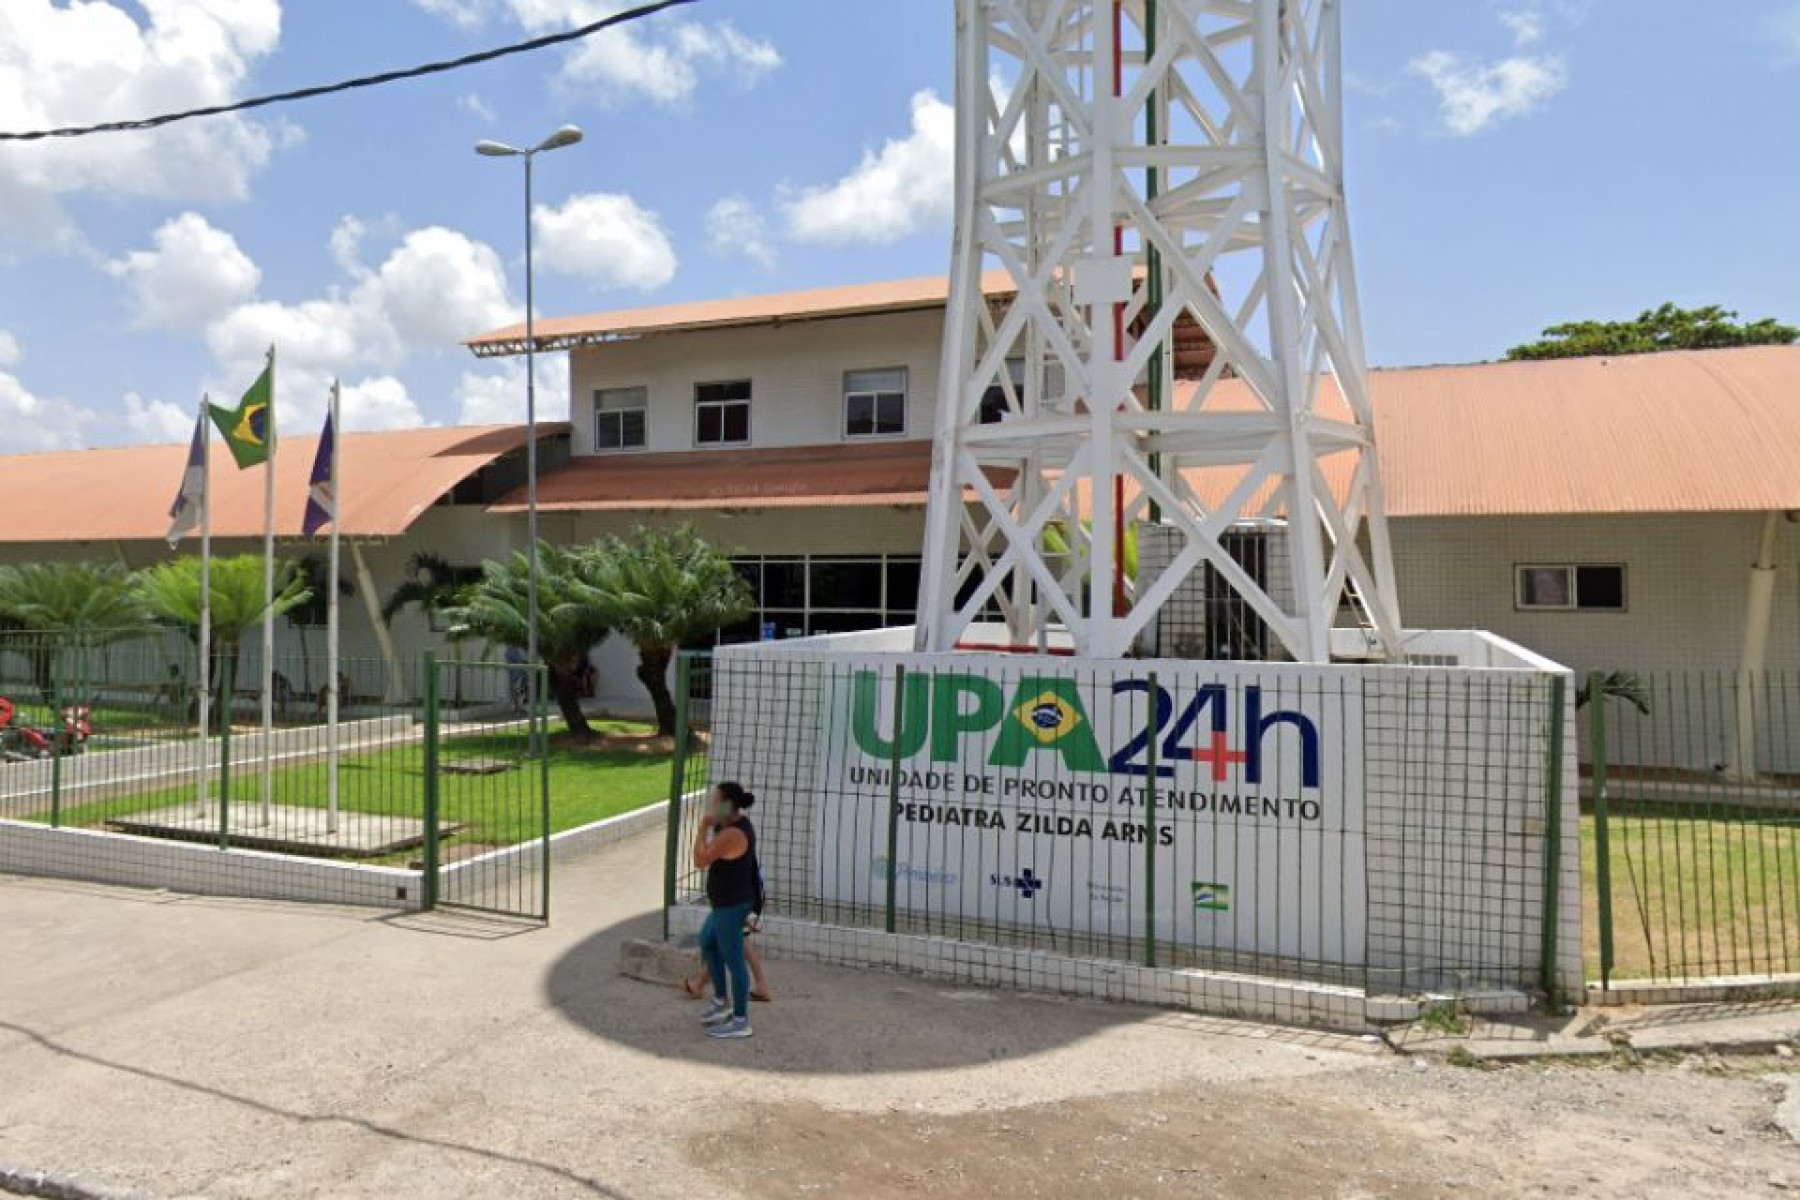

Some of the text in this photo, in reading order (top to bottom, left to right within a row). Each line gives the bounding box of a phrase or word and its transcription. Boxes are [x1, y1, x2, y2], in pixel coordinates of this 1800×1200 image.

[852, 670, 1108, 772] UPA
[850, 766, 1320, 820] UNIDADE DE PRONTO ATENDIMENTO
[1017, 812, 1093, 838] ZILDA
[1102, 820, 1174, 846] ARNS
